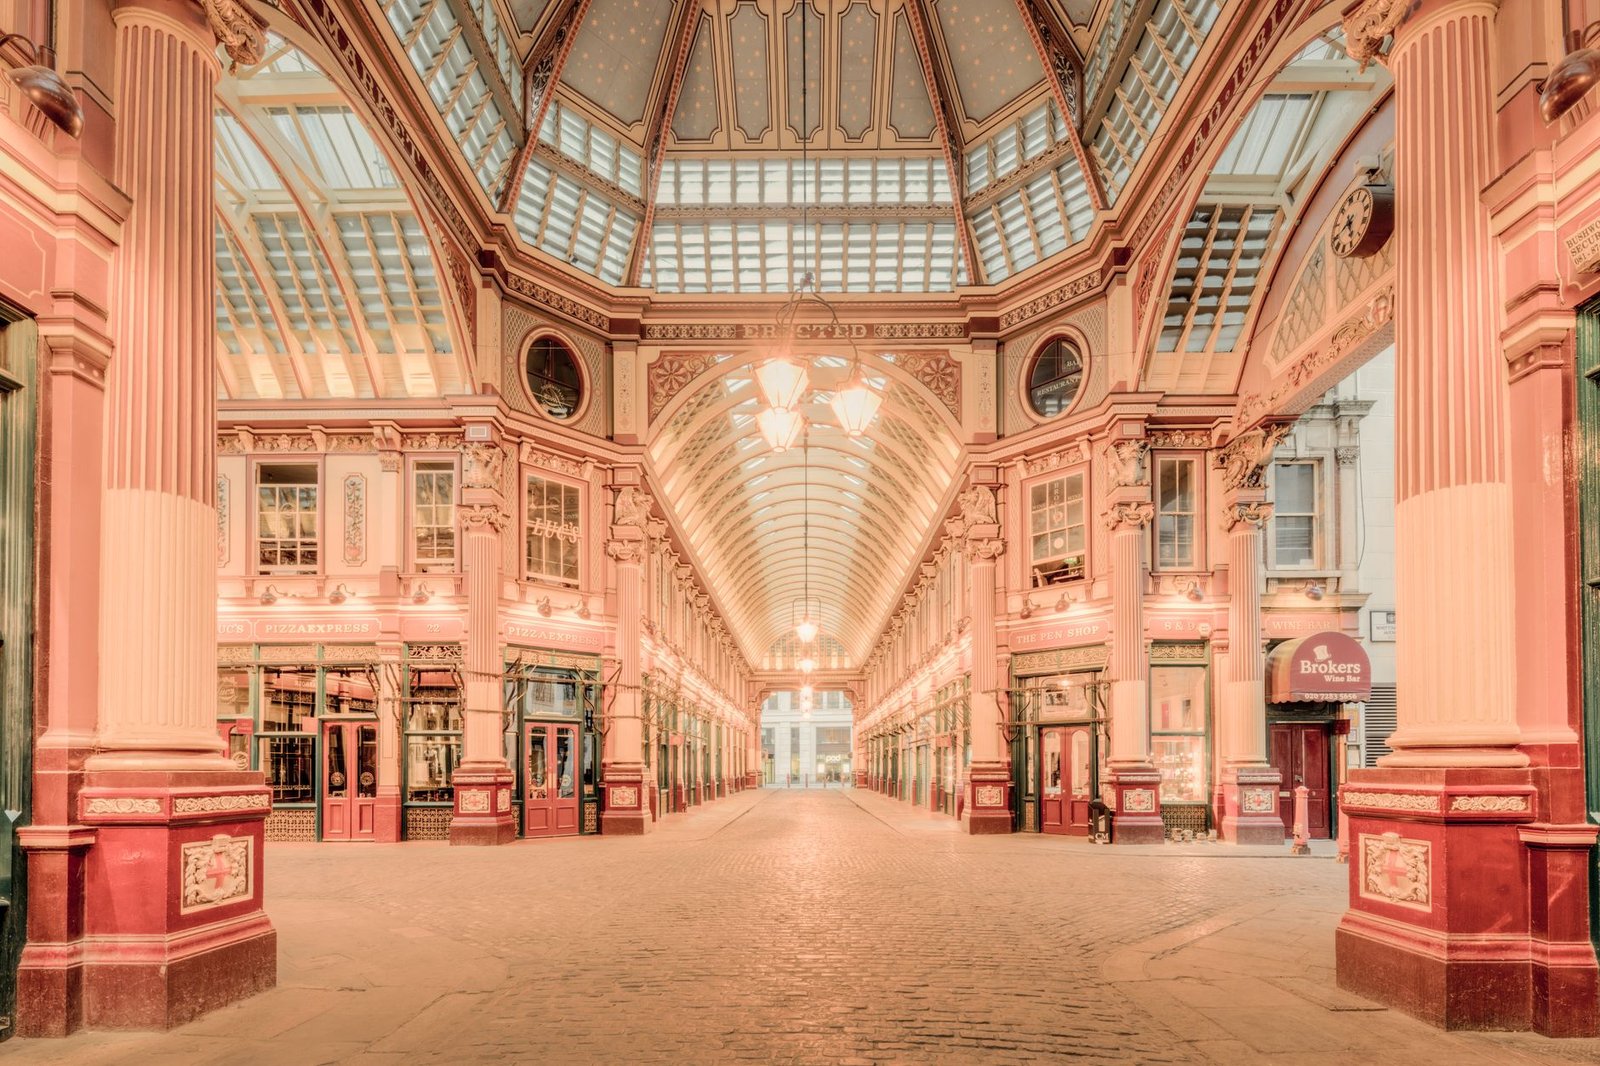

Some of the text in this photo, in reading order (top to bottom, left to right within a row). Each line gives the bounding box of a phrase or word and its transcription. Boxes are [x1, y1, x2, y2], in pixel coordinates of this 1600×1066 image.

[743, 324, 866, 338] ERCTED
[1037, 379, 1079, 396] RESTAURANT
[532, 518, 579, 543] LUC'S
[265, 624, 369, 633] PIZZAEXPRESS
[427, 624, 439, 632] 22
[1017, 626, 1099, 644] THE PEN SHOP
[508, 627, 599, 645] PIZZAEXPRESS
[1300, 660, 1361, 673] Brokers
[825, 754, 840, 762] pod
